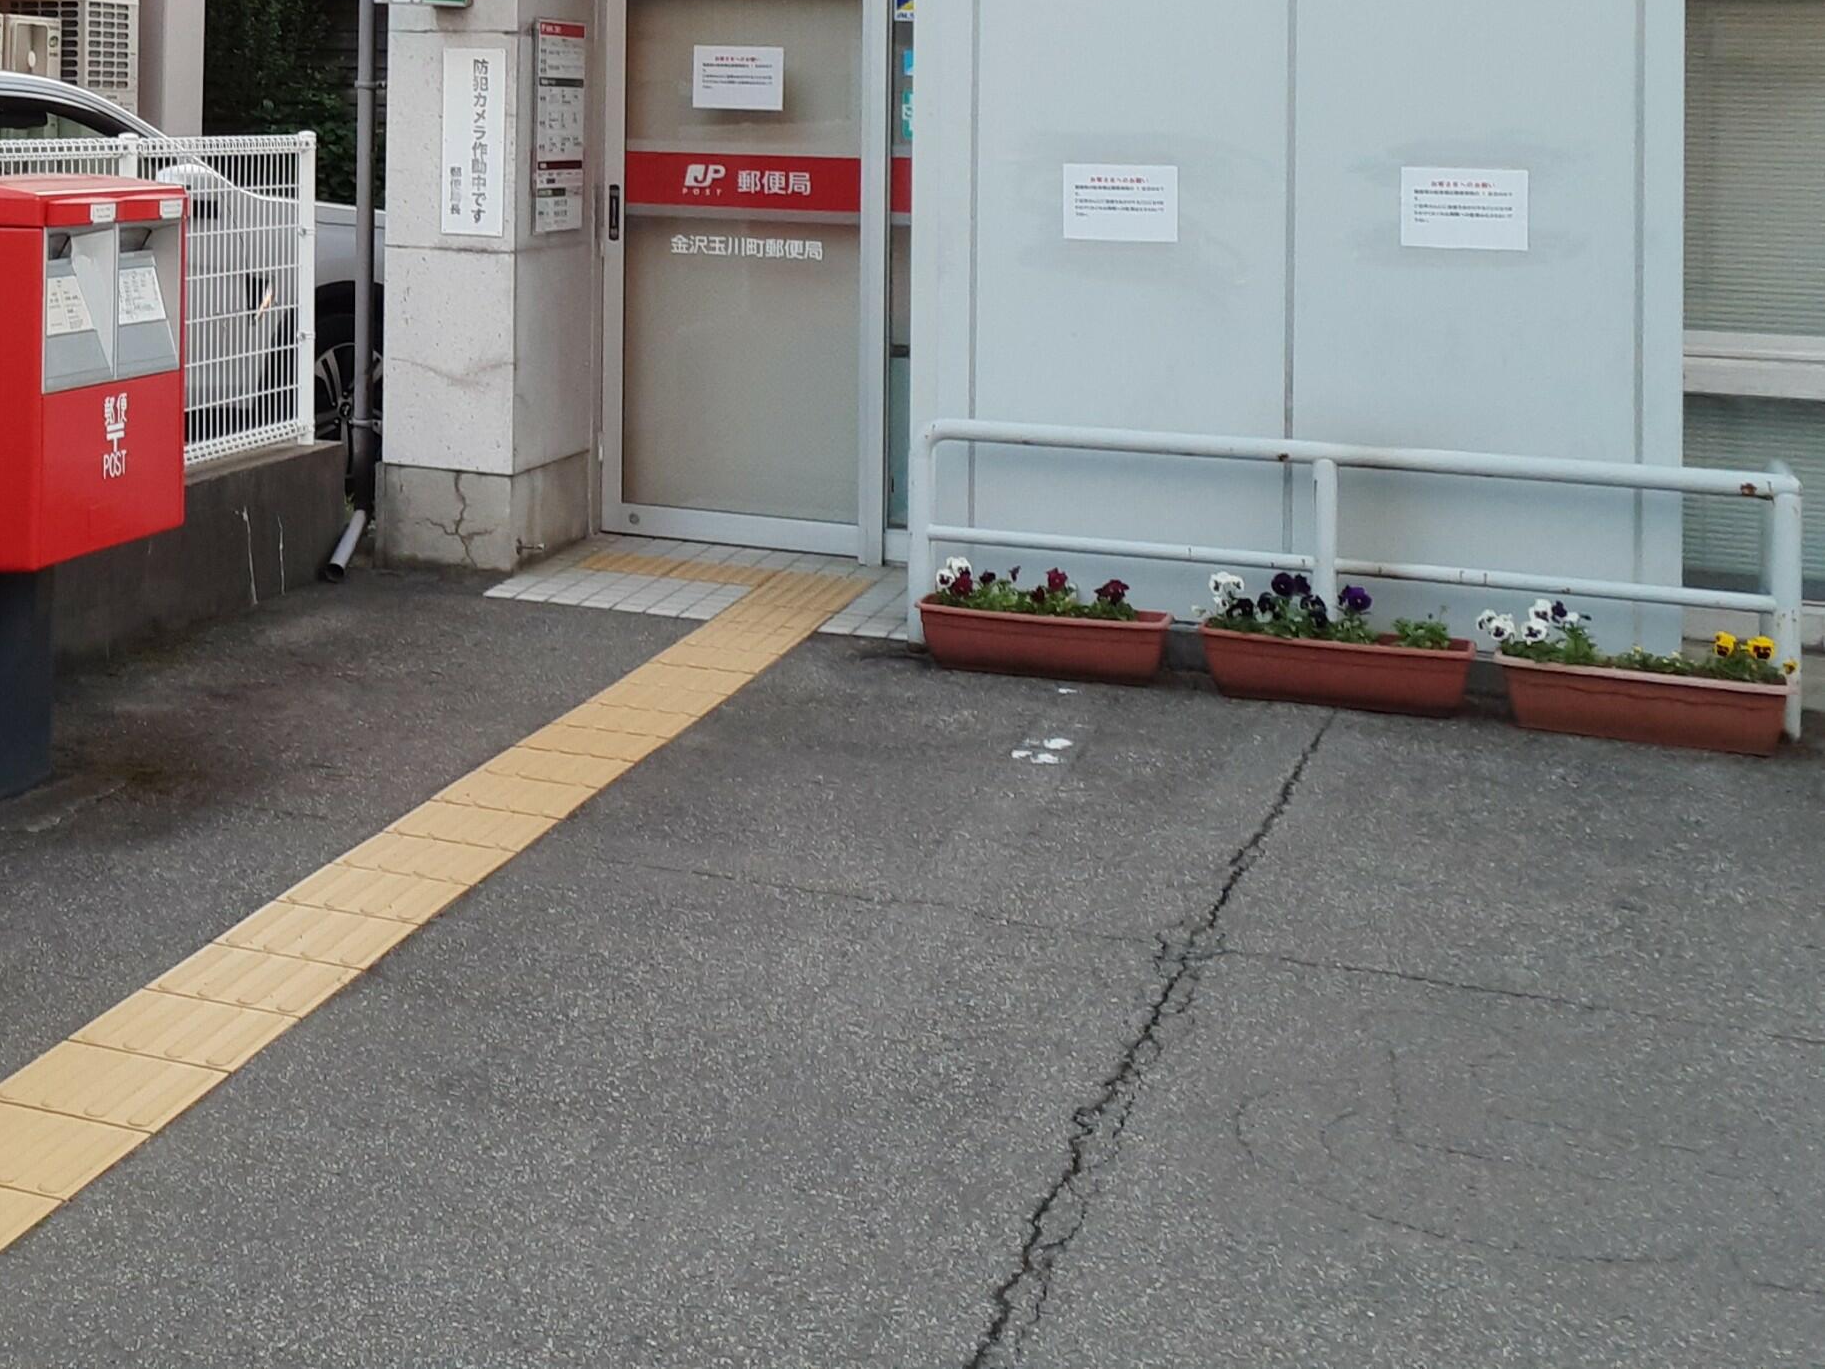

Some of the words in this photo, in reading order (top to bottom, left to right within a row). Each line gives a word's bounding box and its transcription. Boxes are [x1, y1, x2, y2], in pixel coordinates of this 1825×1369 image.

[471, 58, 490, 224] 防犯カメラ作動中です
[682, 187, 722, 196] POST
[736, 170, 812, 196] 郵便局
[670, 234, 823, 262] 金沢玉川町郵便局
[104, 392, 128, 425] 郵便
[103, 448, 128, 479] POST
